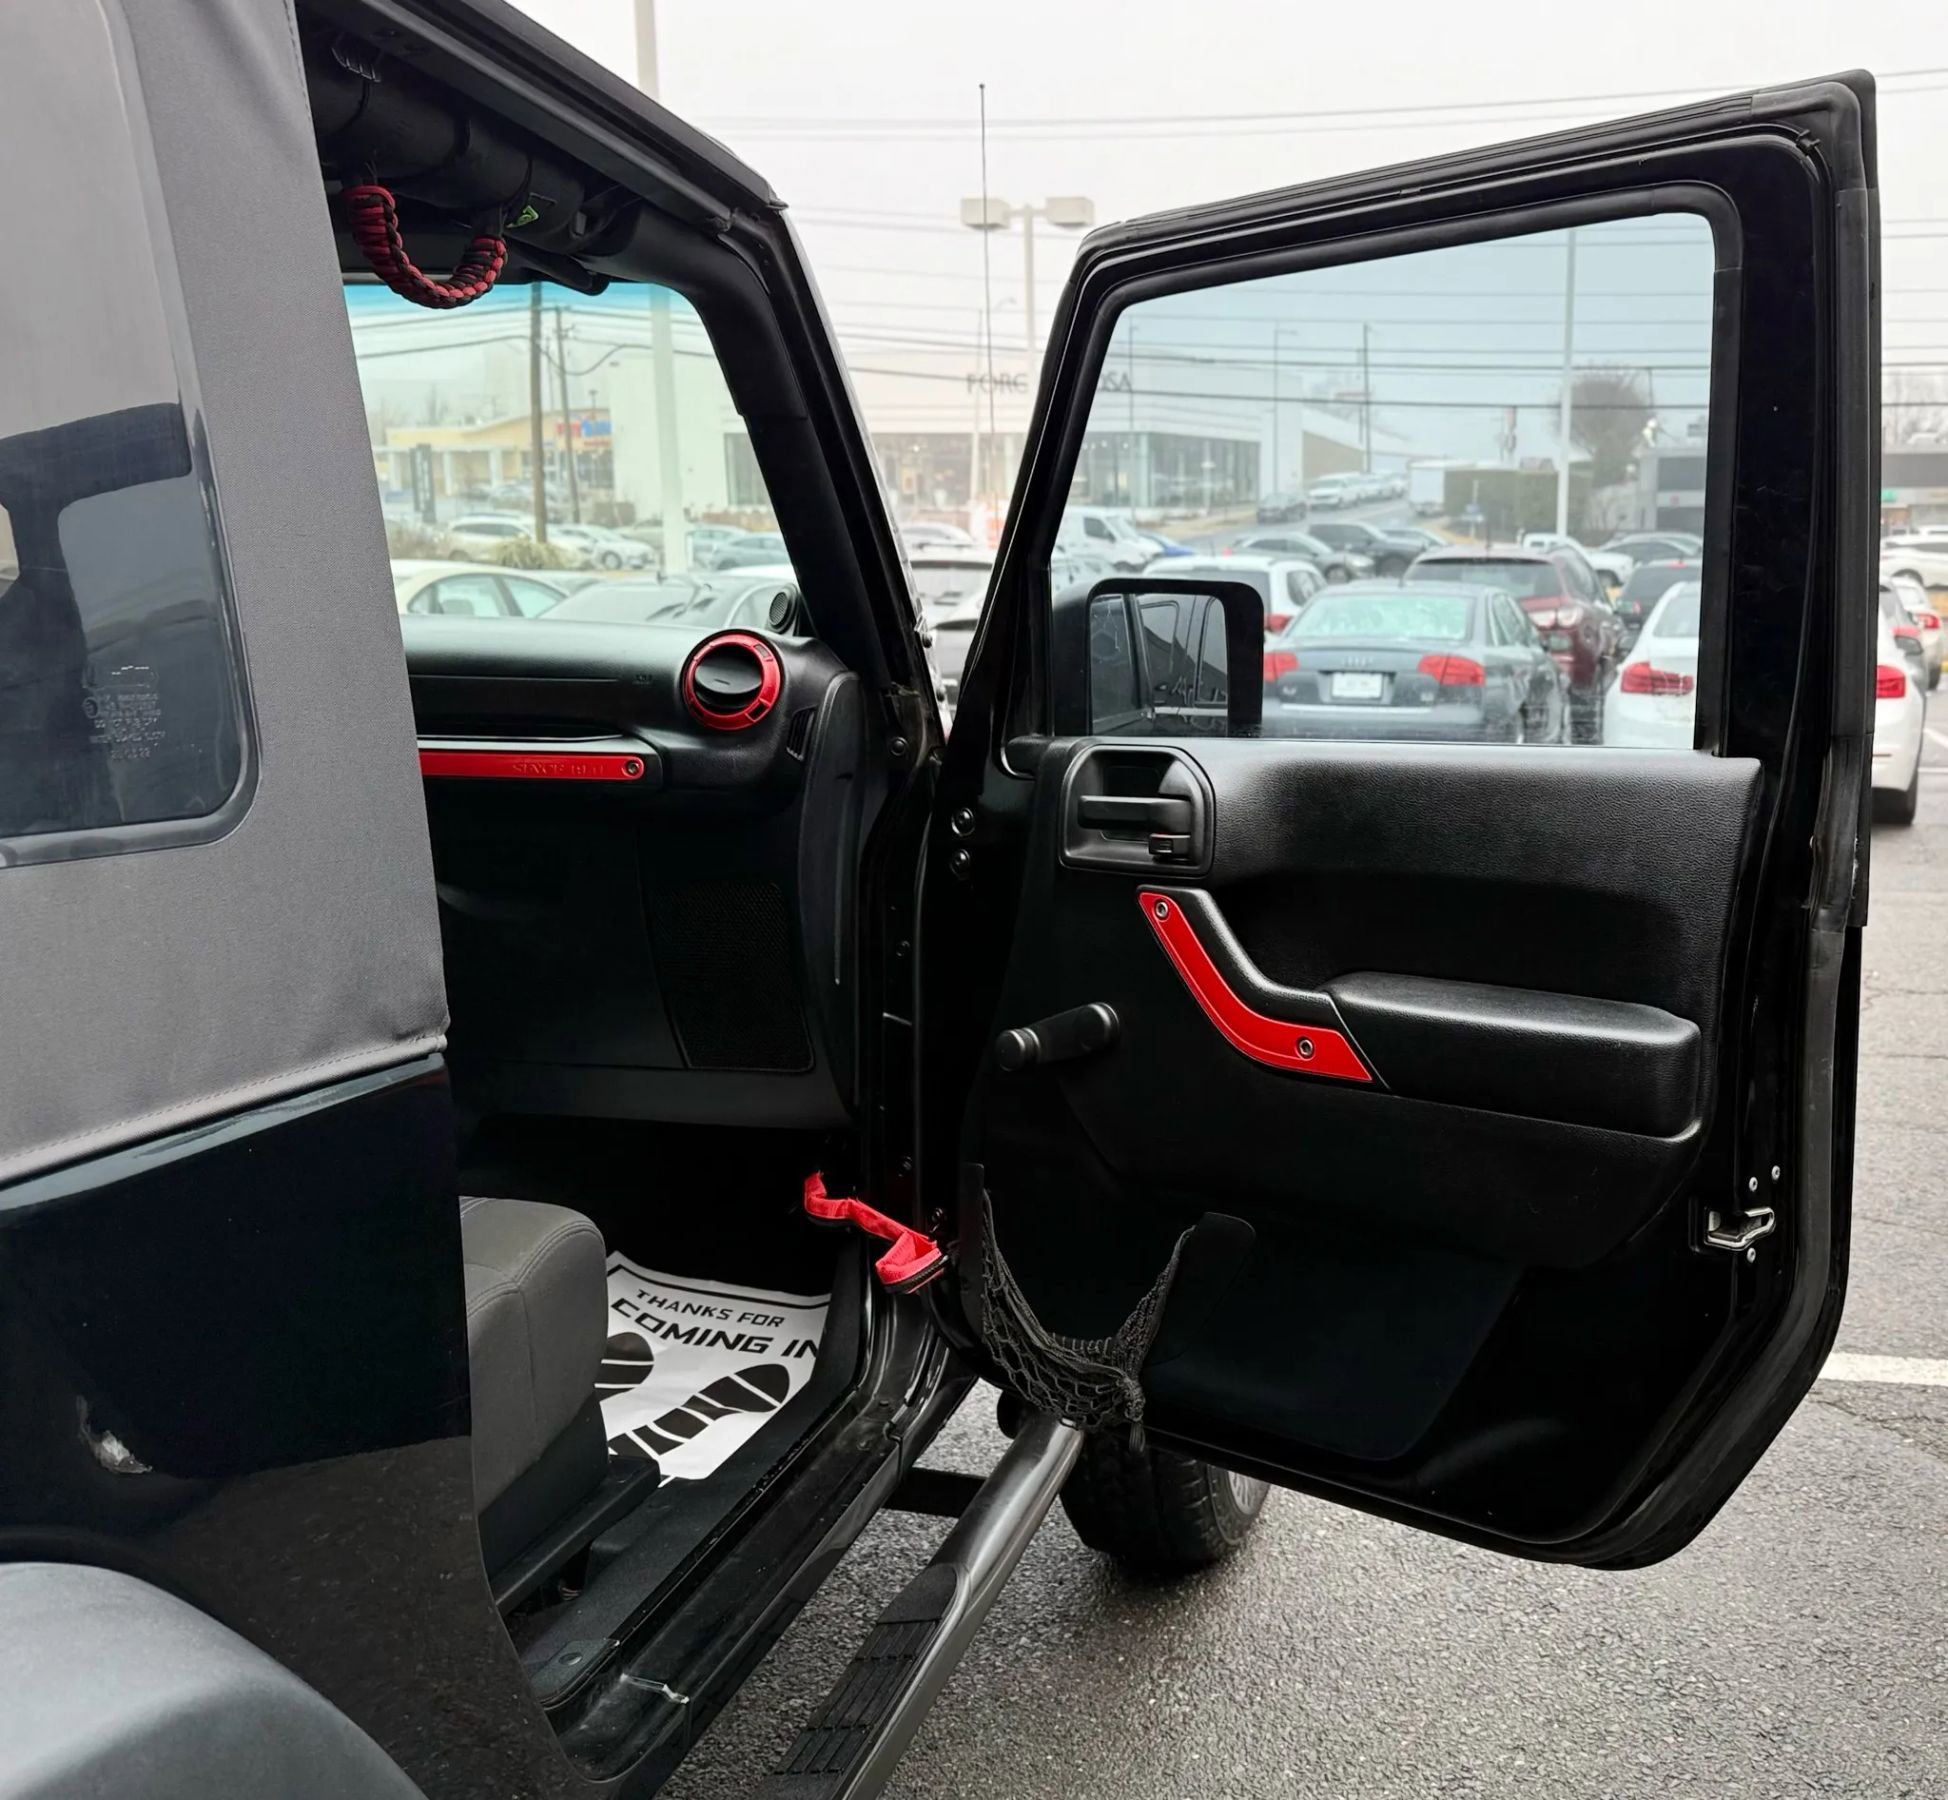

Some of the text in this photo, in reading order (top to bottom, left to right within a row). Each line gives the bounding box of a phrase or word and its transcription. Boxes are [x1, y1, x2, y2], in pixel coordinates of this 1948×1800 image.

[610, 1297, 775, 1354] COMING
[636, 1288, 785, 1328] THANKS FOR
